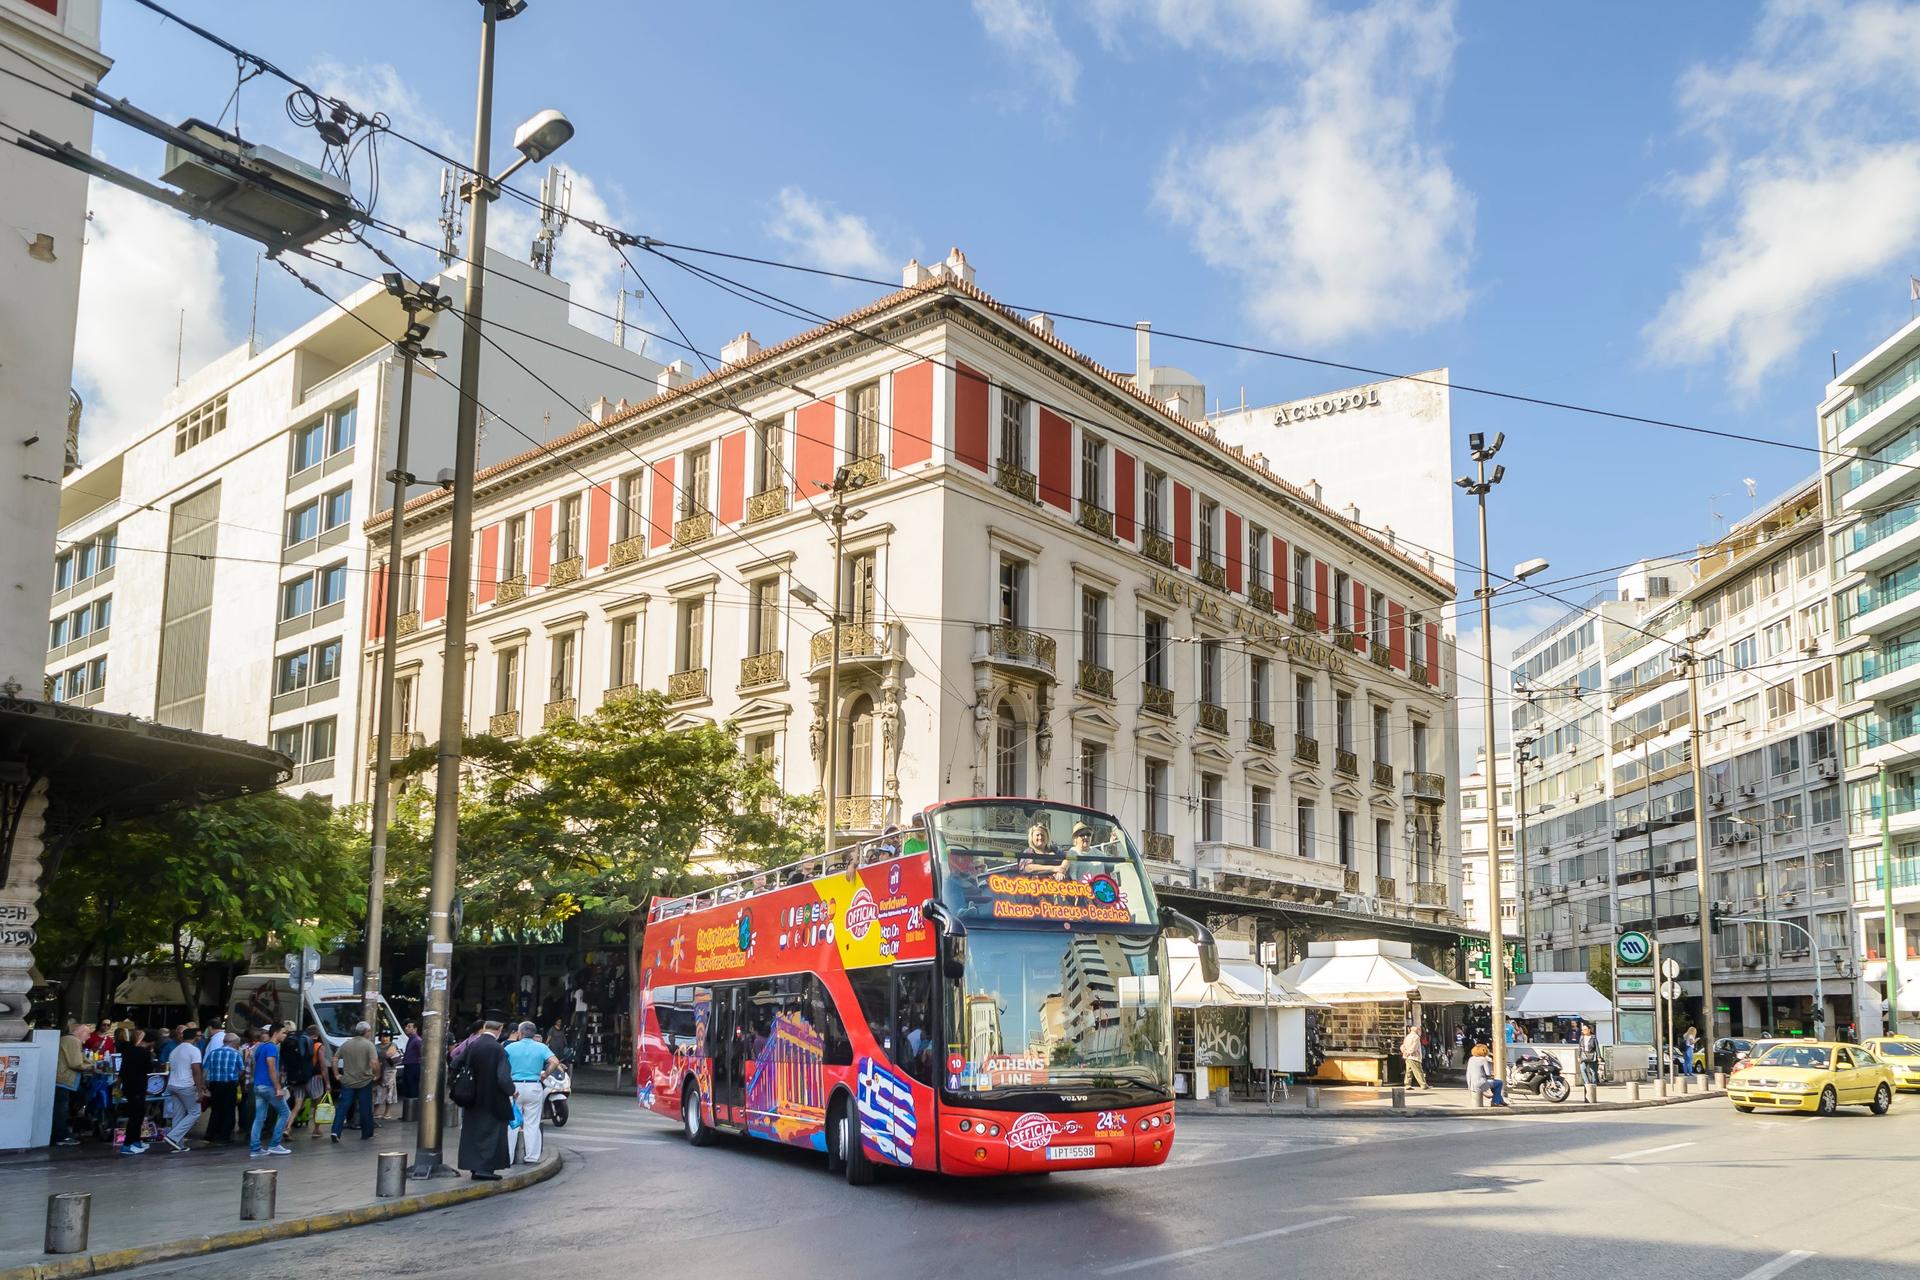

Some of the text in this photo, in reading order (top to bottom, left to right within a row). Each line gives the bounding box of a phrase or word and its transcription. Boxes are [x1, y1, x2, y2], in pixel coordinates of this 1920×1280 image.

[848, 905, 877, 926] OFFICIAL
[994, 901, 1130, 922] Athens Piraeus Beaches
[951, 1059, 962, 1069] 10
[986, 1058, 1045, 1072] ATHENS
[1000, 1073, 1032, 1086] LINE
[1096, 1112, 1113, 1130] 24
[1010, 1121, 1059, 1143] OFFICIAL
[1027, 1136, 1049, 1148] TOUR
